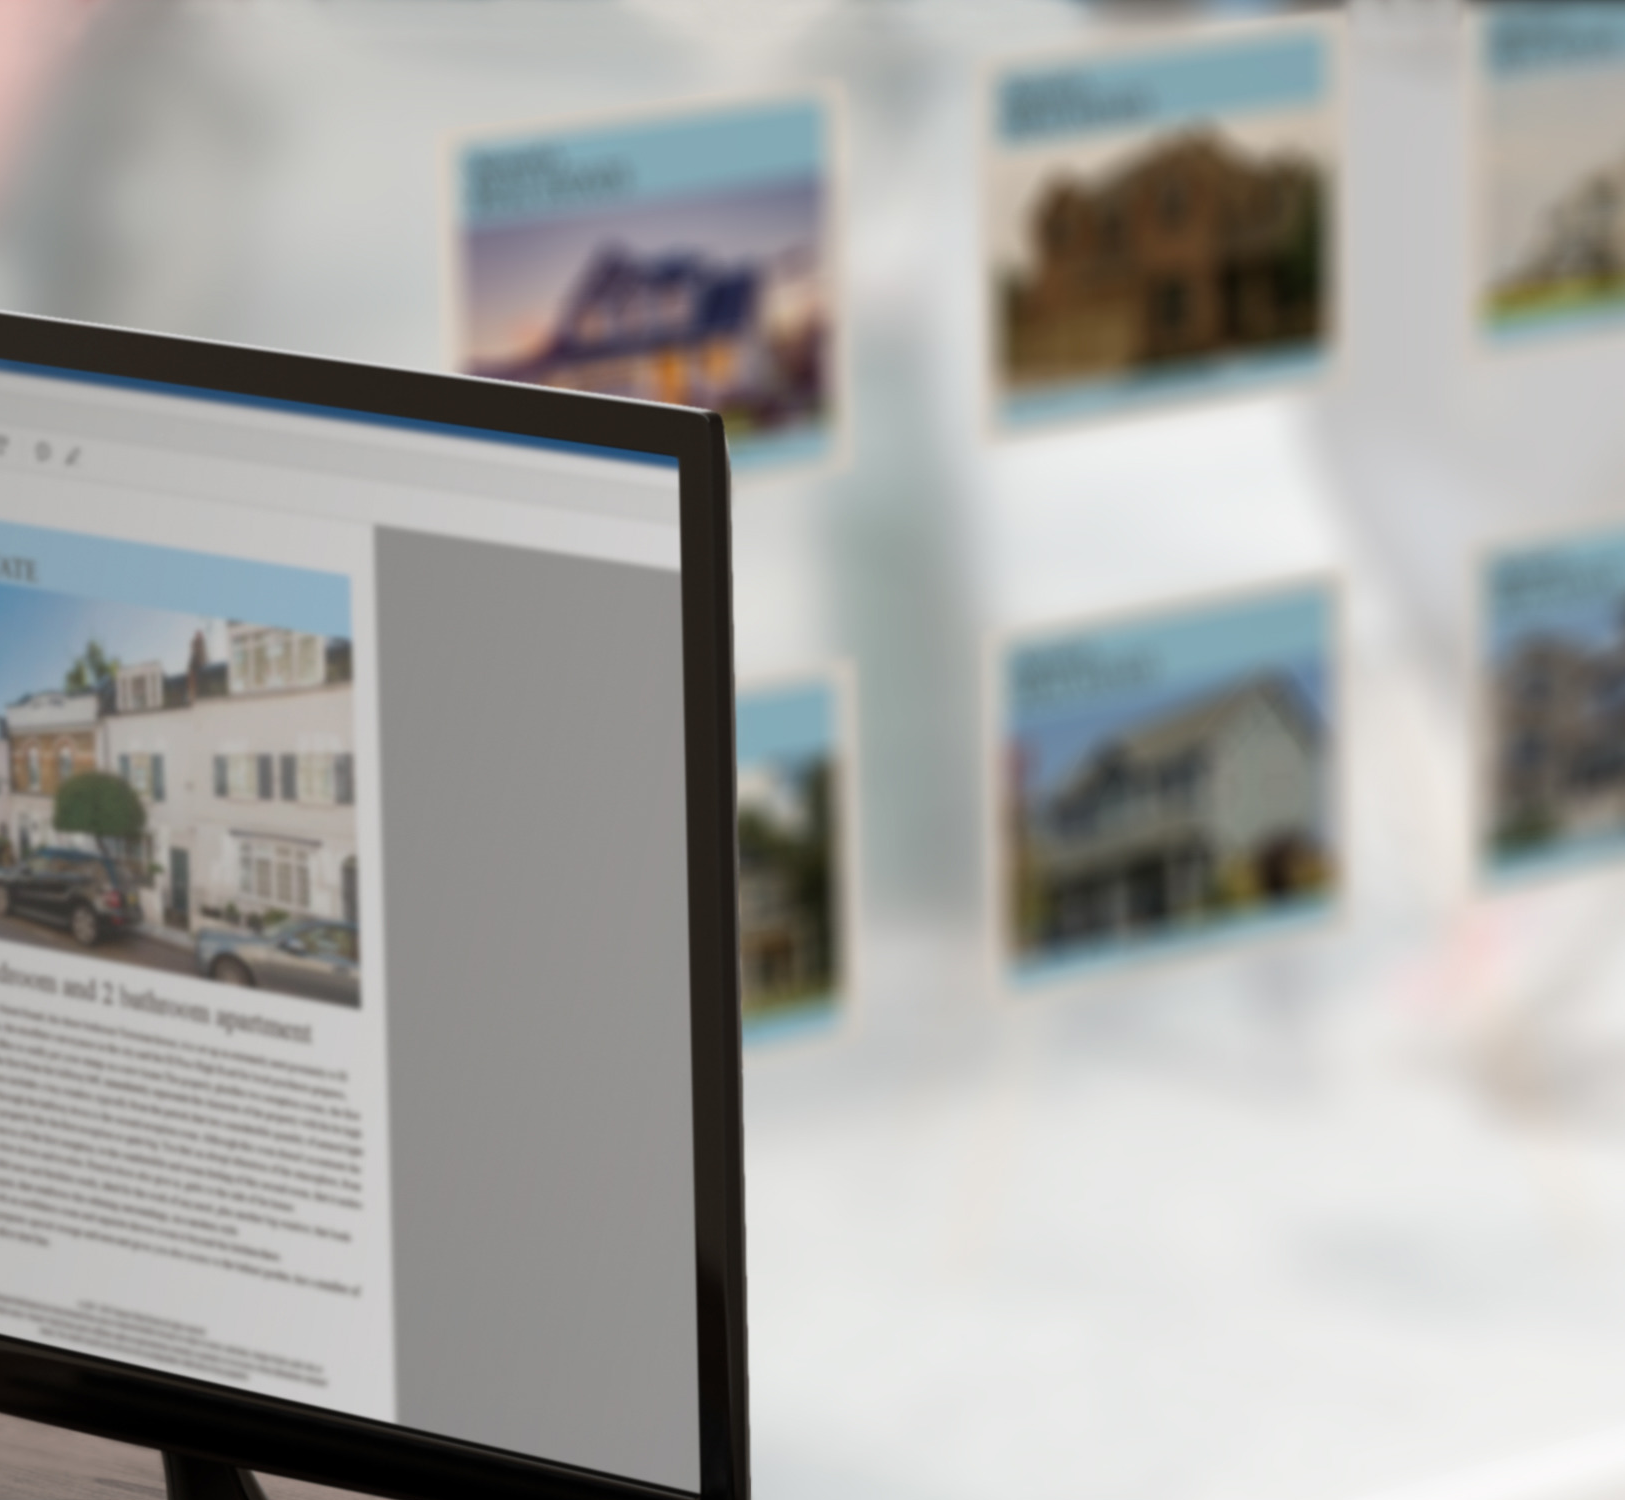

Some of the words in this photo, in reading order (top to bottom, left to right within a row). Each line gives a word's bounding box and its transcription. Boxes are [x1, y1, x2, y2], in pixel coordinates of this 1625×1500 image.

[62, 977, 96, 1002] and
[102, 981, 114, 1005] 2
[119, 987, 210, 1025] bathroom
[215, 1007, 314, 1046] apartment
